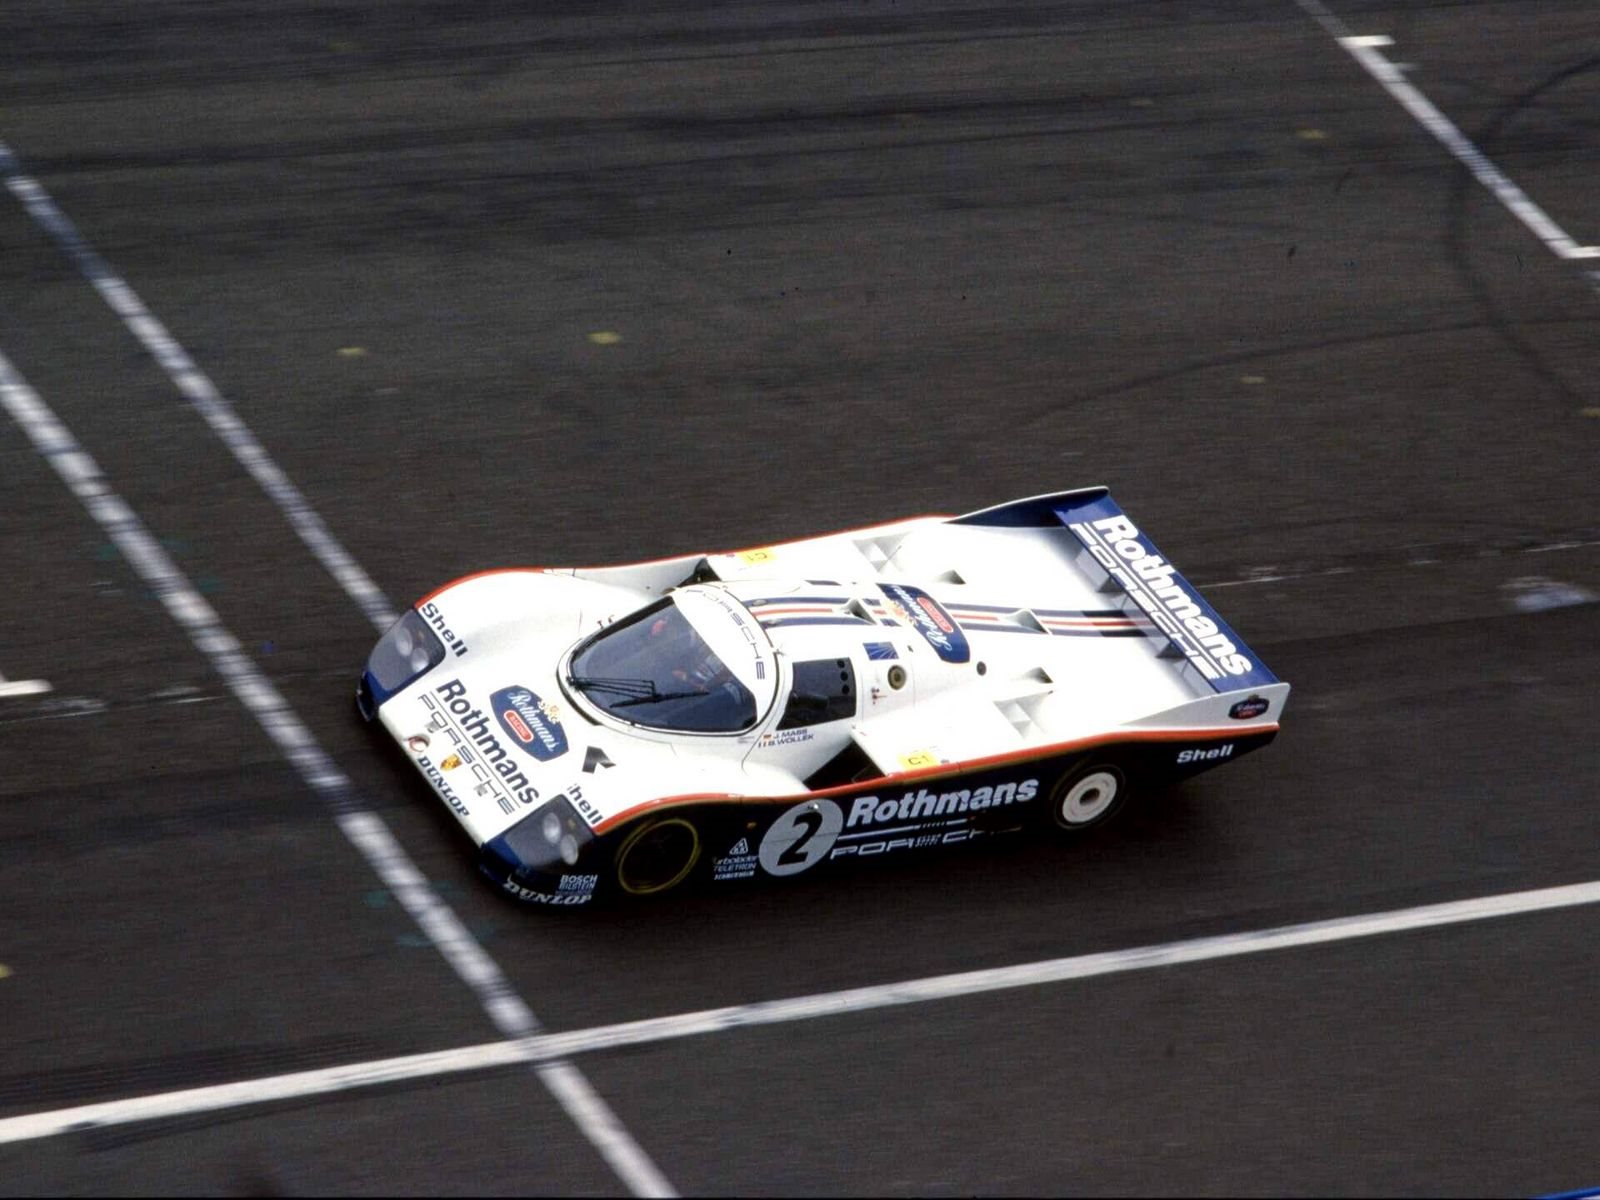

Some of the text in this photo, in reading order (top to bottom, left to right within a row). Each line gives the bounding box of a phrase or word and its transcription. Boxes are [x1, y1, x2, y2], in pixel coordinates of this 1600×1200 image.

[1068, 523, 1221, 680] PORSCHE
[1092, 514, 1253, 676] Rothmans
[422, 602, 469, 658] Shell
[436, 678, 540, 805] Rothmans
[506, 690, 560, 752] Rothmans
[417, 694, 516, 816] PORSCHE
[1177, 744, 1234, 764] Shell
[417, 755, 471, 817] DUNLOP
[846, 778, 1040, 828] Rothmans
[777, 810, 824, 867] 2
[830, 826, 1021, 860] PORCH
[502, 881, 592, 905] DUNLOP
[560, 874, 598, 884] BOSCH
